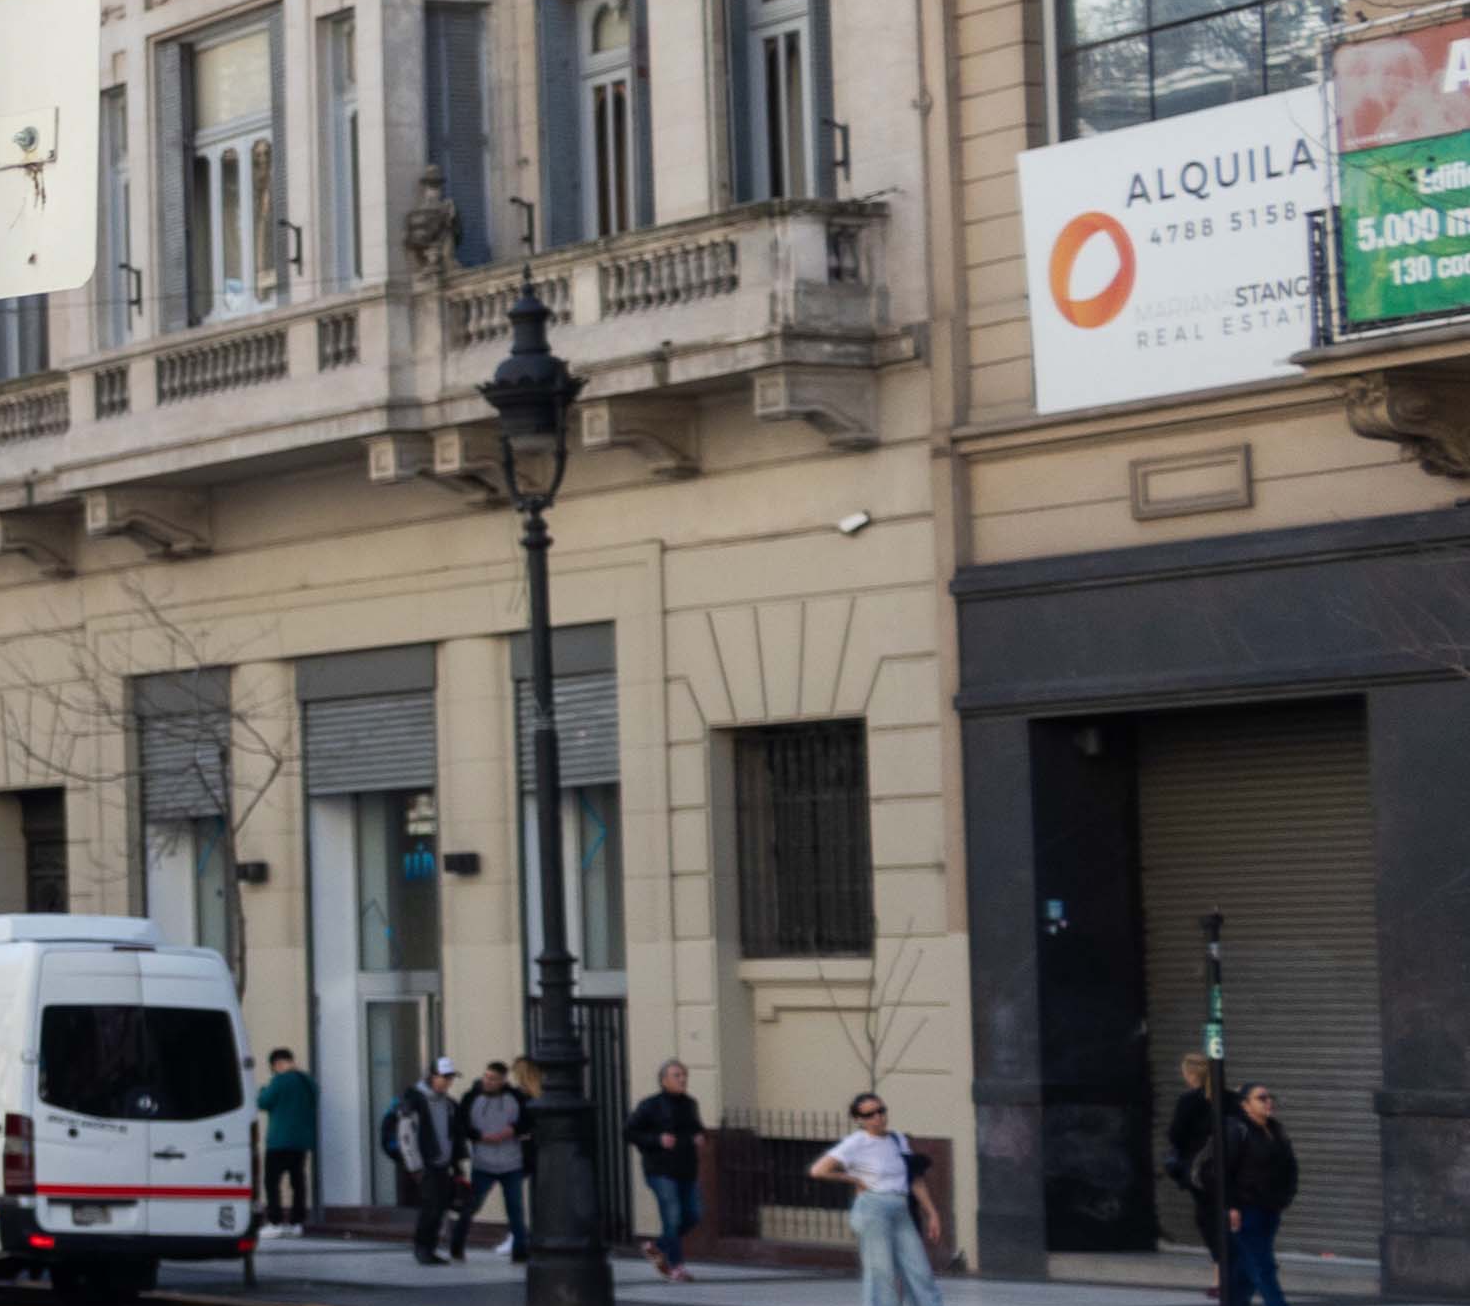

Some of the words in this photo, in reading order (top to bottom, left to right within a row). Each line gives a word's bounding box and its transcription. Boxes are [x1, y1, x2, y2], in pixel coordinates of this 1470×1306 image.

[1126, 138, 1318, 208] ALQUILA
[1150, 218, 1214, 246] 4788
[1230, 201, 1297, 233] 5158
[1357, 207, 1439, 251] 5.000
[1389, 255, 1431, 286] 130
[1136, 322, 1204, 349] REAL
